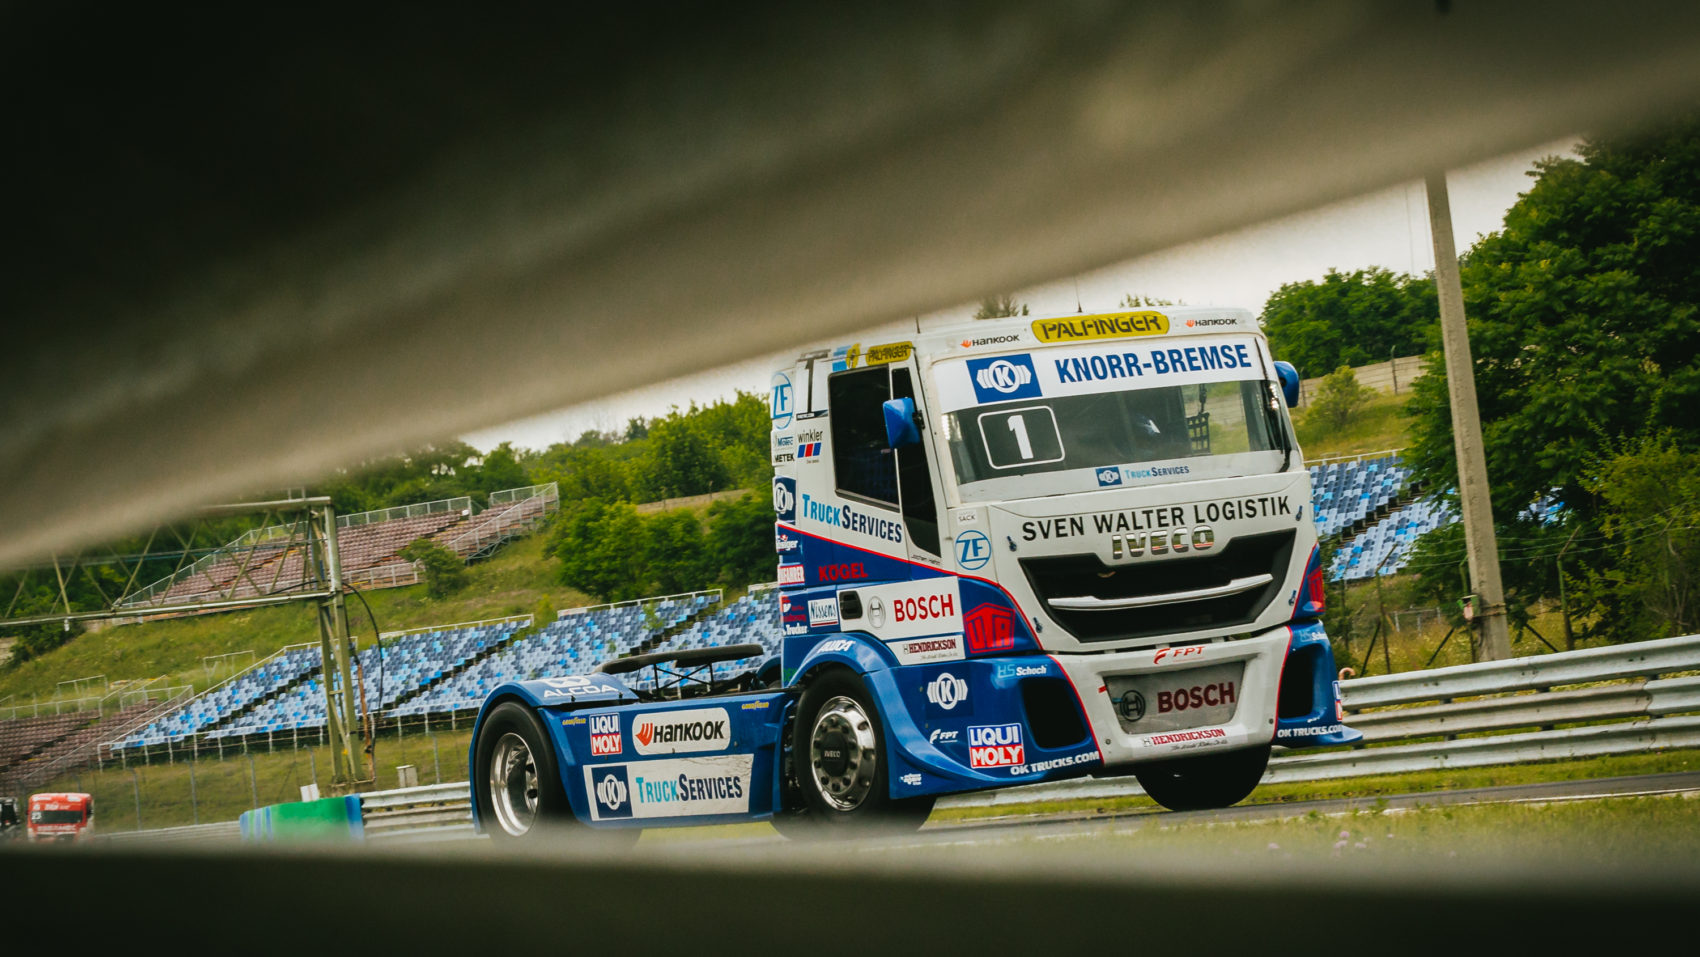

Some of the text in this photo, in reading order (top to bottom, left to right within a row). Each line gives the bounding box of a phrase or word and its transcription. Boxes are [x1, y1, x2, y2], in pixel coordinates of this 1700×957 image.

[1041, 316, 1162, 340] PALFINGER
[1055, 344, 1252, 384] KNORR-BREMSE
[797, 429, 823, 443] winkler
[1007, 415, 1034, 459] 1
[1022, 495, 1291, 541] SVEN WALTER LOGISTIK
[956, 537, 990, 563] ZF
[1112, 525, 1215, 560] IVECO
[894, 594, 954, 622] BOSCH
[965, 605, 1012, 650] UTA
[909, 638, 957, 653] HENDRICKSON
[1173, 646, 1205, 657] FPT
[544, 684, 619, 698] ALCOA
[1157, 682, 1236, 713] BOSCH
[591, 715, 619, 734] LIQUI
[940, 731, 958, 739] FPT
[970, 725, 1019, 746] LIQUI
[592, 735, 622, 755] MOLY
[1151, 728, 1226, 745] HENDRICKSON
[972, 746, 1023, 766] MOLY
[1010, 750, 1101, 776] OK TRUCKS.COM
